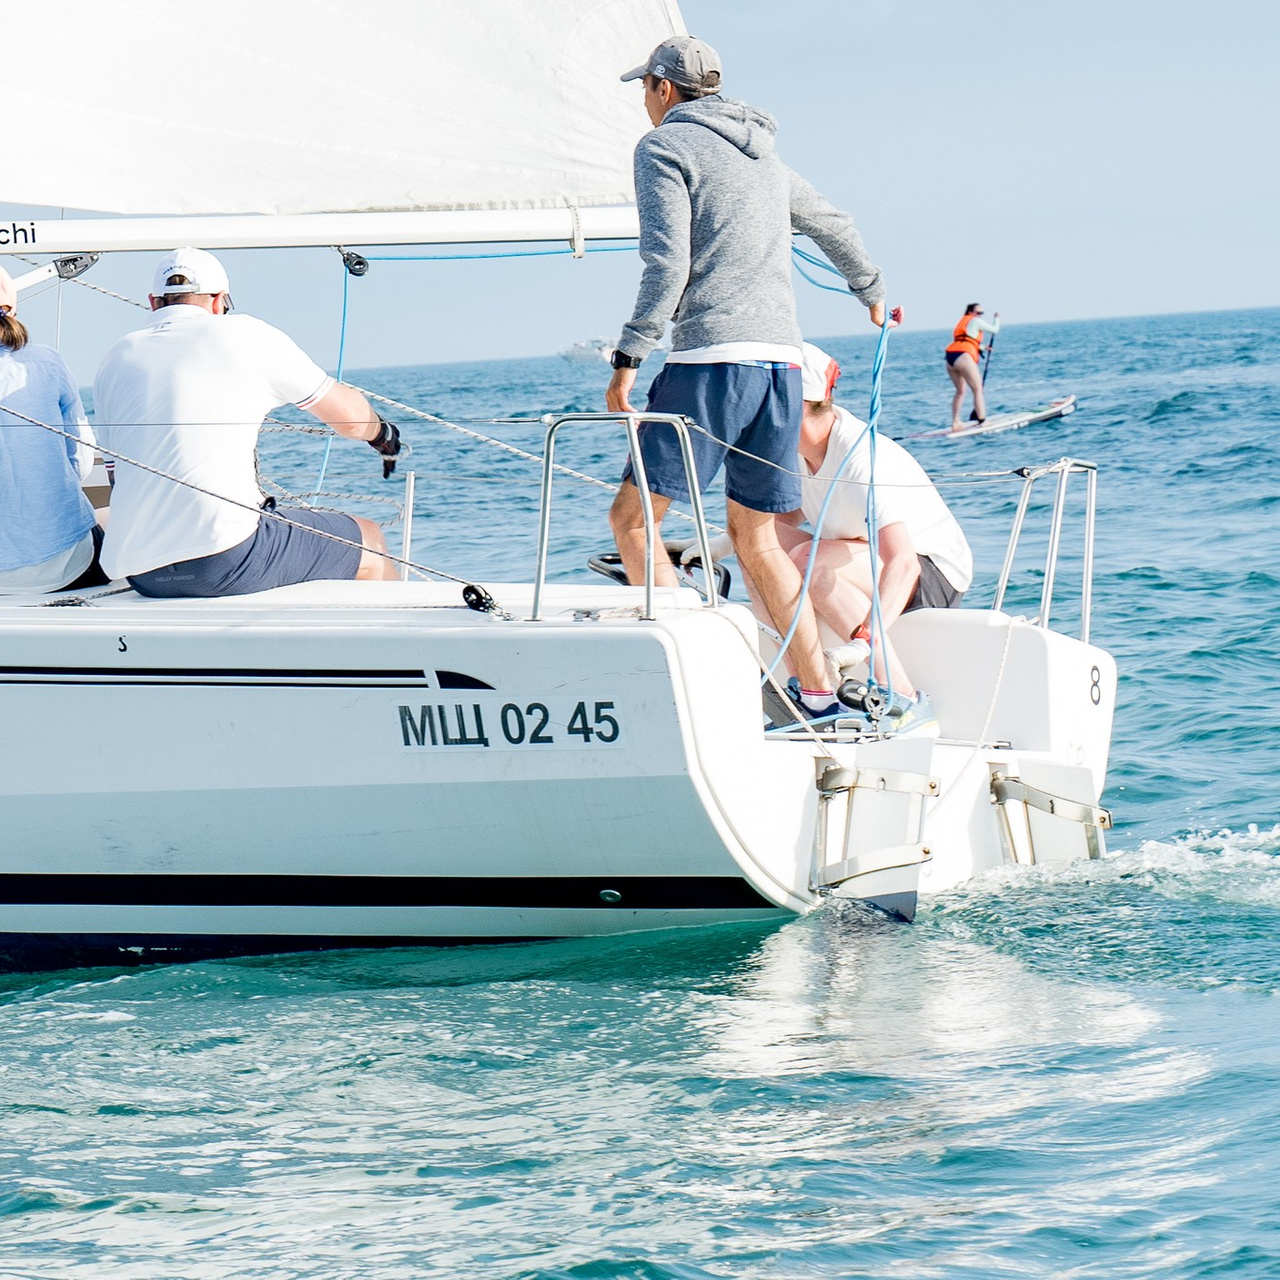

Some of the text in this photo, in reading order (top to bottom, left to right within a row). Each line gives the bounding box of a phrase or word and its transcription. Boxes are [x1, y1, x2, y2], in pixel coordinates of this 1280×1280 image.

[1090, 665, 1101, 705] 8
[398, 701, 620, 747] МЩ 02 45
